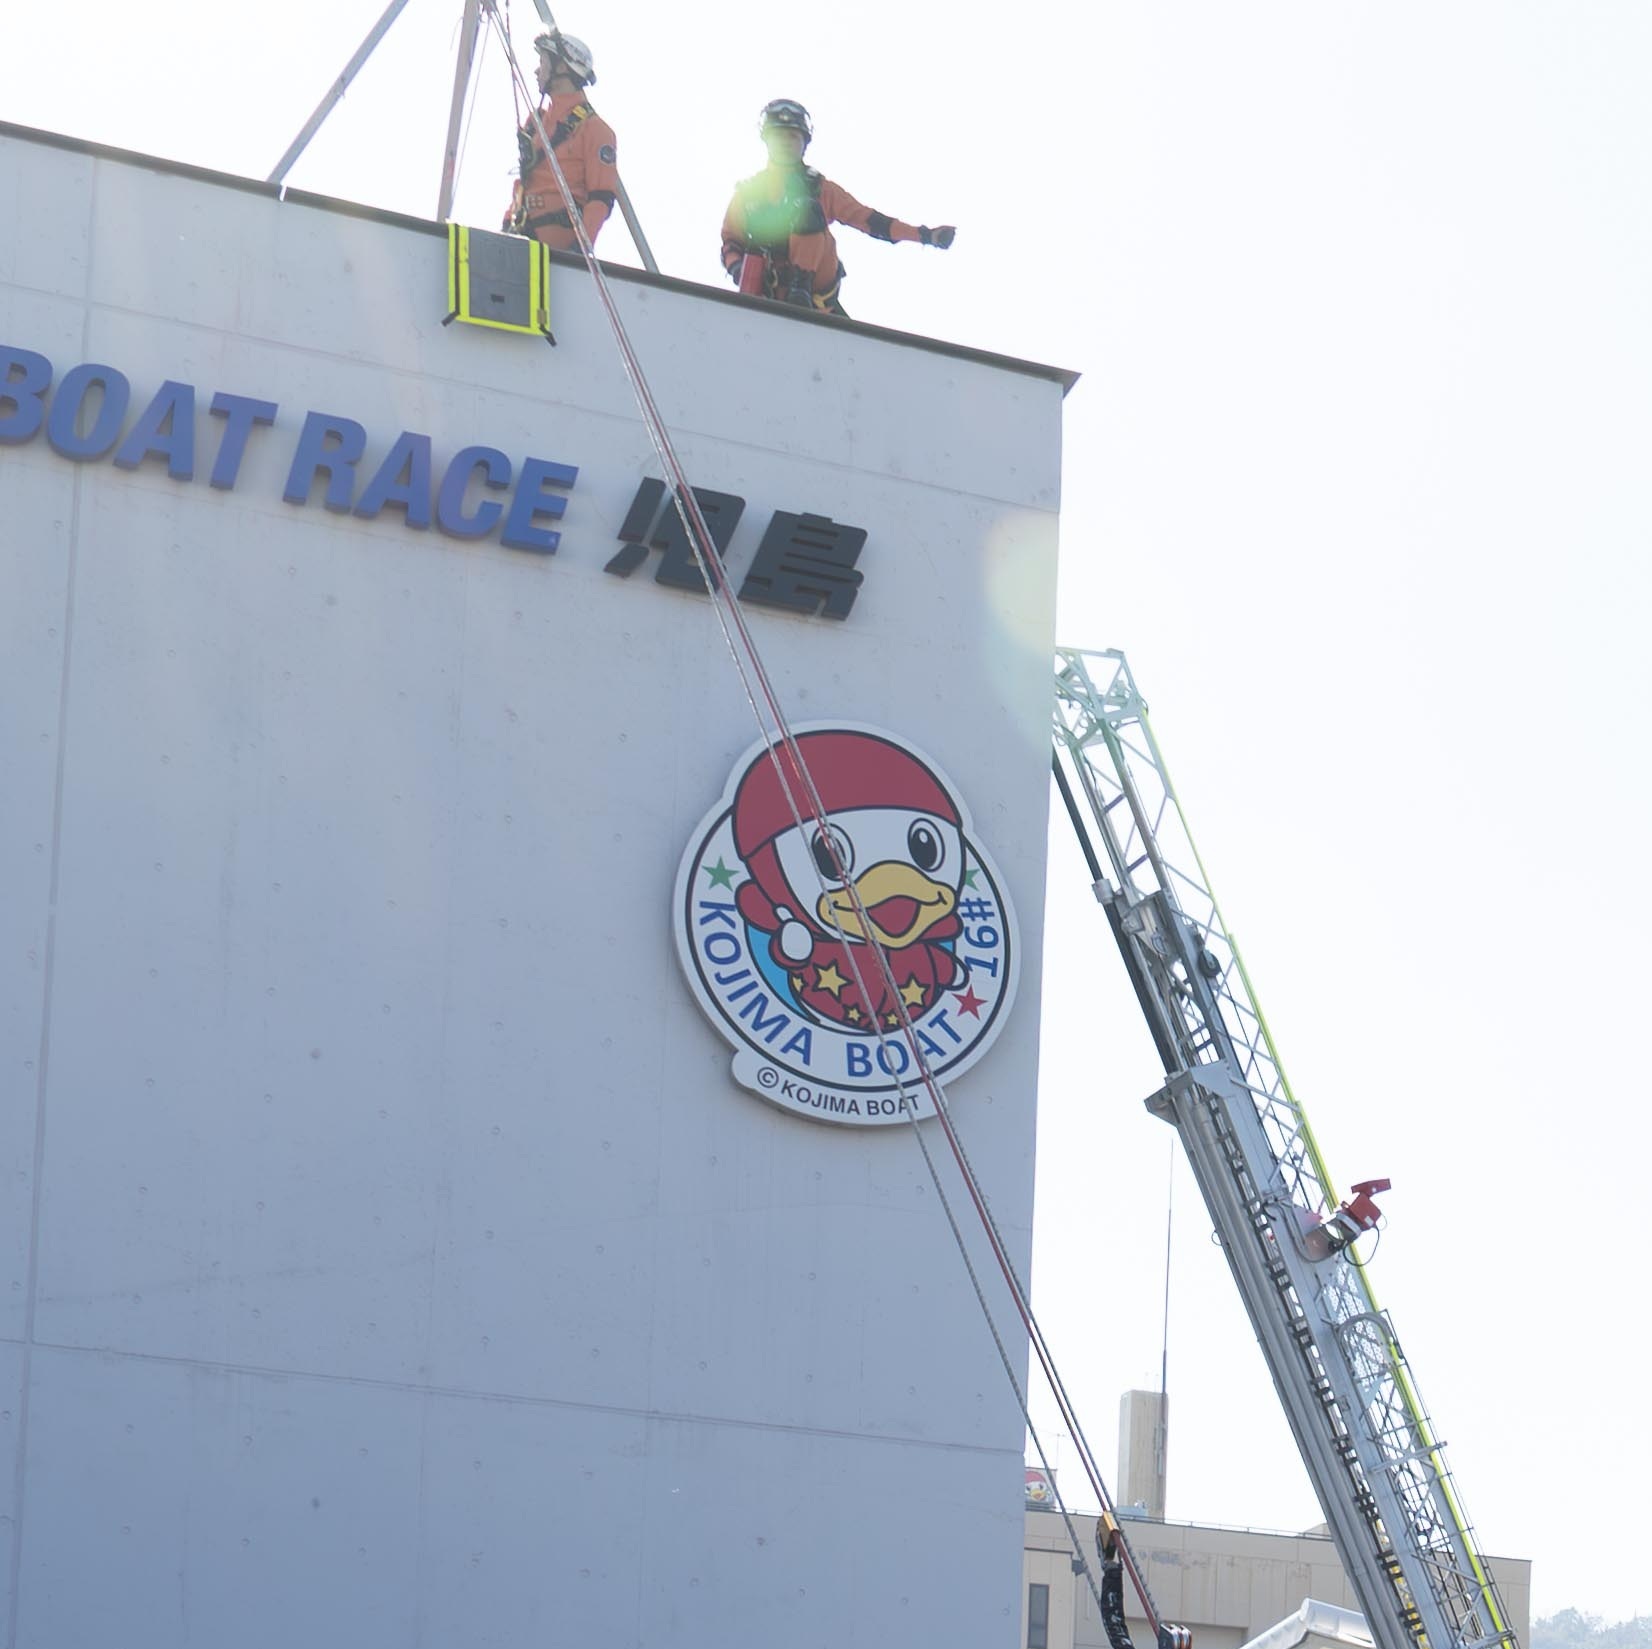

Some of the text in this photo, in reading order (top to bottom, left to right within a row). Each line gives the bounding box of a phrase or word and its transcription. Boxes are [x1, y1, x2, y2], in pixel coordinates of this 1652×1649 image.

[0, 345, 580, 555] BOAT RACE
[603, 476, 869, 622] 児島
[698, 899, 815, 1067] KOJIMA
[846, 1008, 963, 1079] BOAT
[781, 1080, 860, 1116] KOJIMA
[867, 1094, 920, 1116] BOAT
